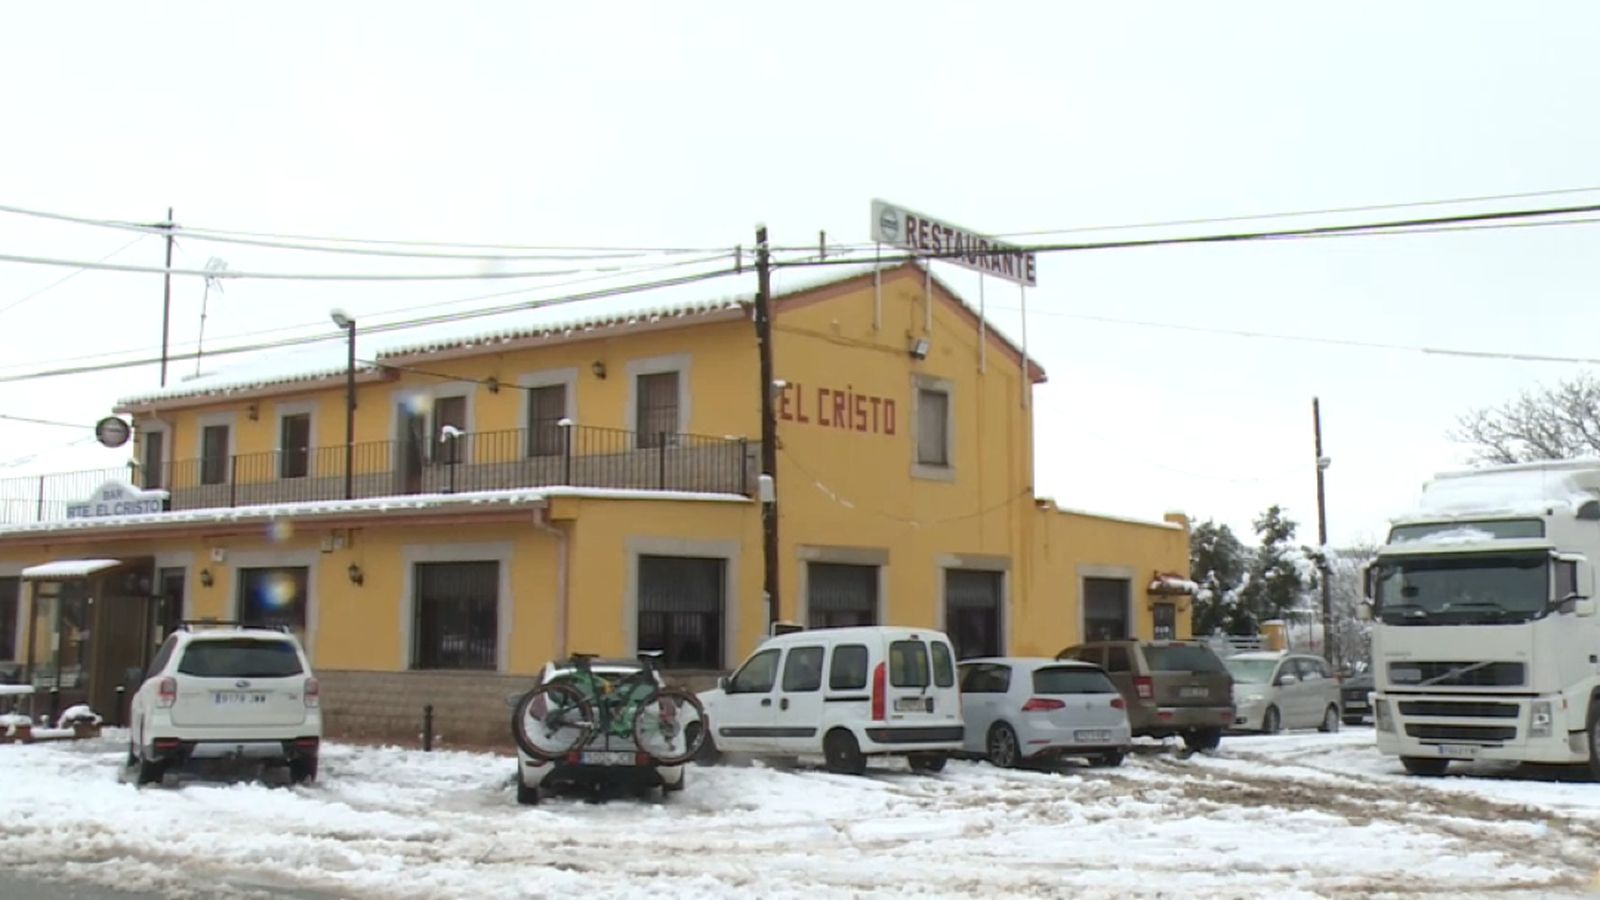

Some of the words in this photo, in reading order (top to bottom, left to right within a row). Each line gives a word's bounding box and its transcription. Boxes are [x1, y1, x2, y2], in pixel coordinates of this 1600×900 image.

[905, 214, 1036, 282] RESTAURANTE
[780, 382, 808, 423] EL
[96, 503, 111, 517] EL
[114, 500, 160, 516] CRISTO
[103, 489, 122, 501] BAR
